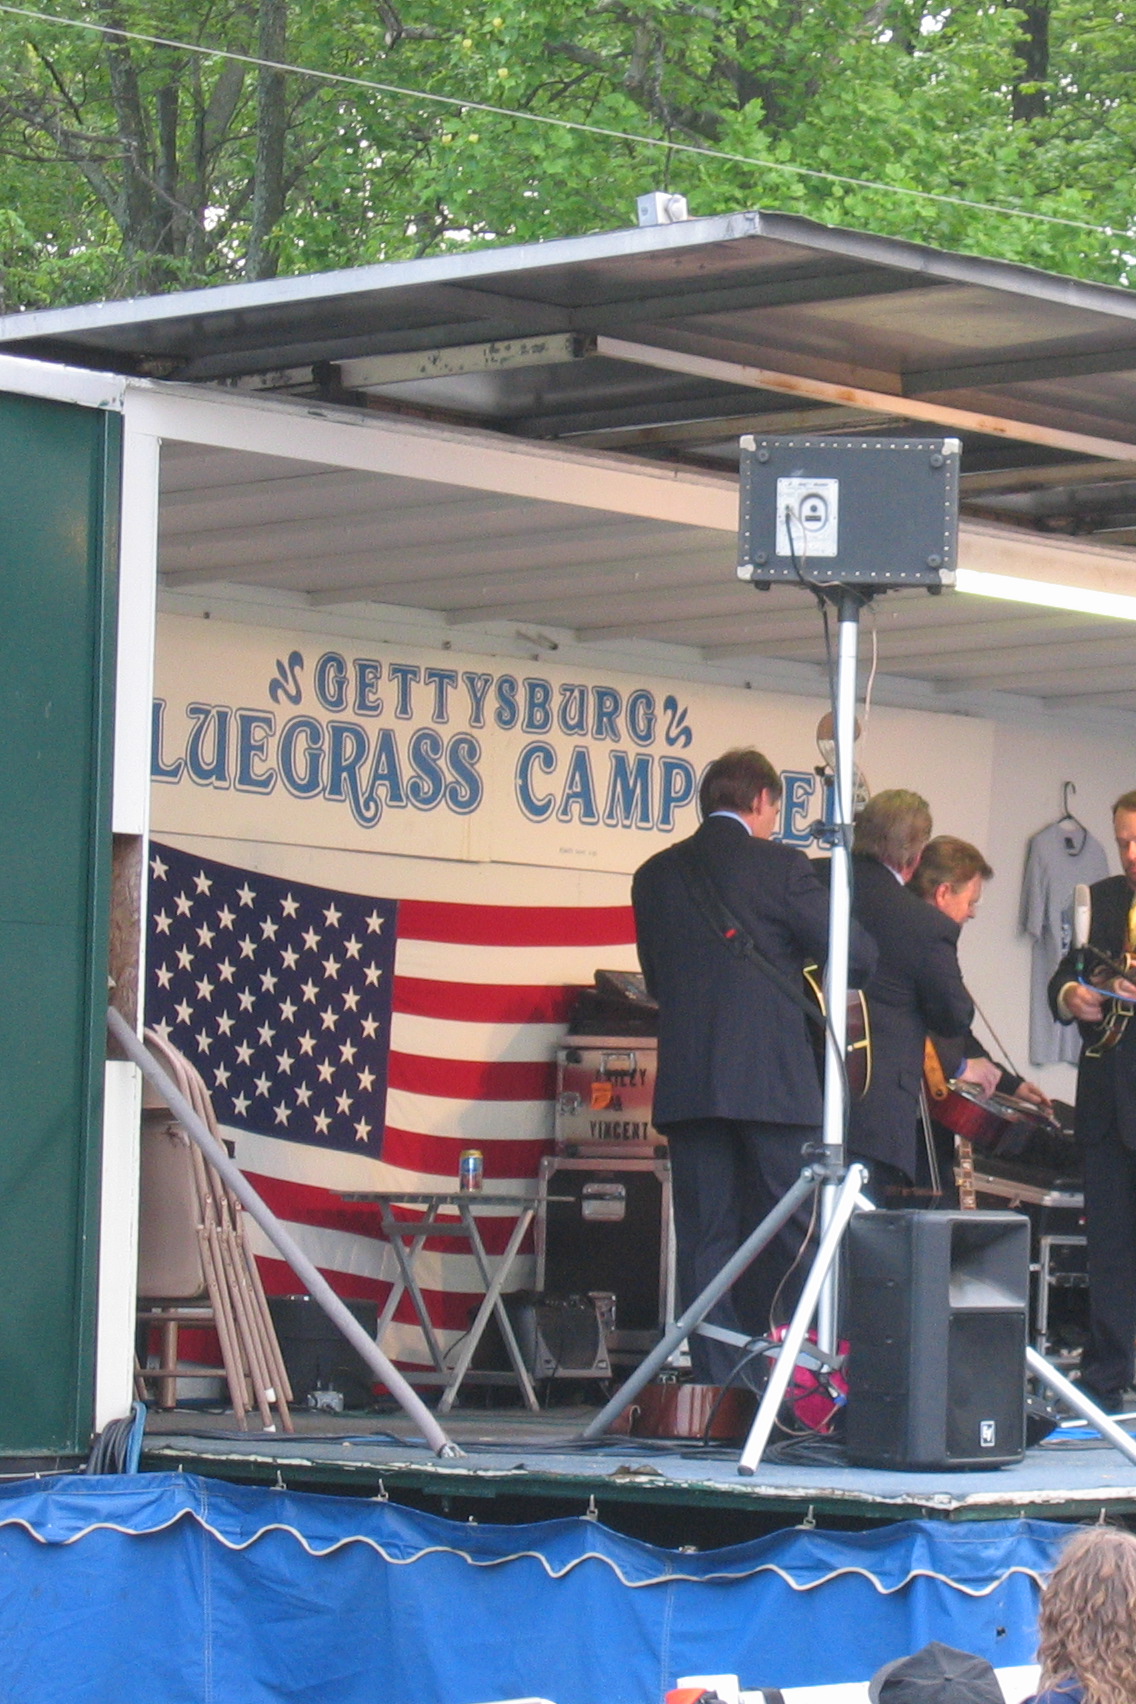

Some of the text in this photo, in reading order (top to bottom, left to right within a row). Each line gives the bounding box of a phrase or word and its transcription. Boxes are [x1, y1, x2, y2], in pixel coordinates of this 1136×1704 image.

[314, 651, 657, 747] GETTYSBURG
[150, 697, 484, 829] LUEGRASS
[590, 1120, 649, 1141] VINCENT
